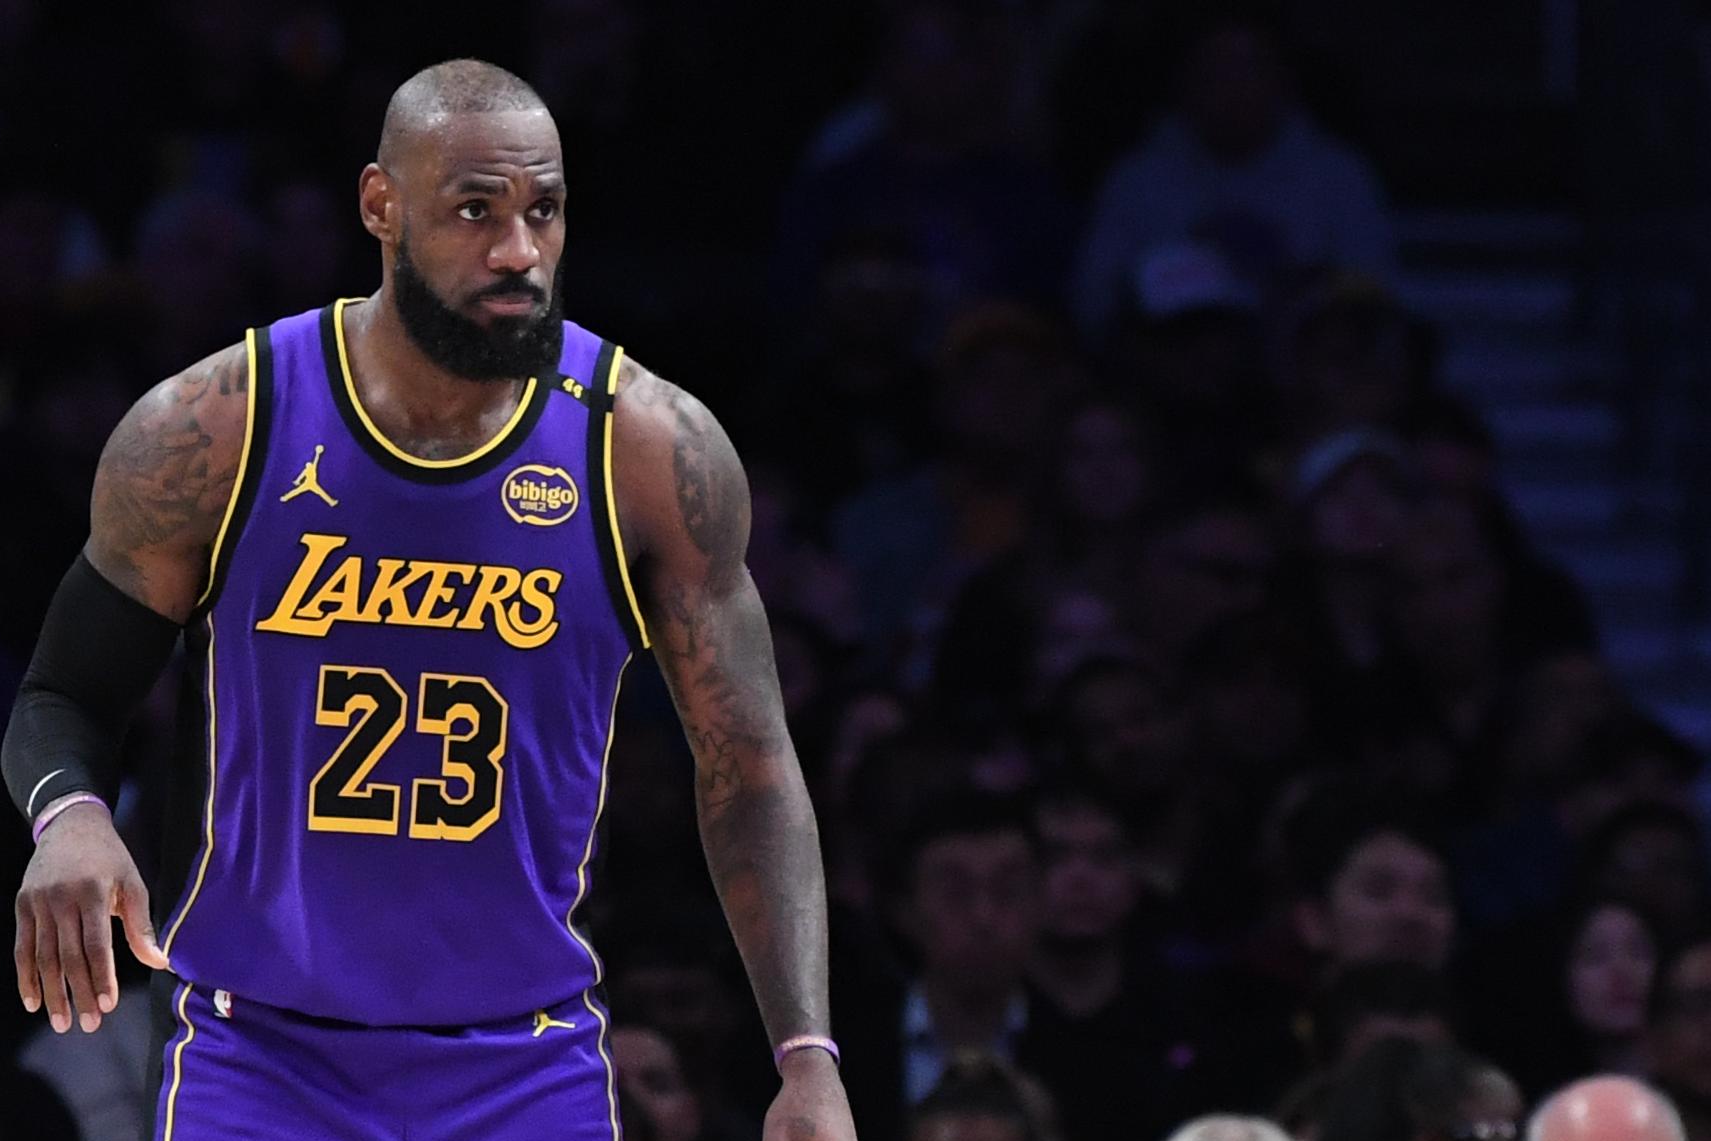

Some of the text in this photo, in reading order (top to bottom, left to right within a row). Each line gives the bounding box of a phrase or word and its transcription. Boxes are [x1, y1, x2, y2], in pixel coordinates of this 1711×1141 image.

[508, 478, 574, 510] bibigo
[254, 532, 564, 650] LAKERS
[307, 663, 510, 842] 23
